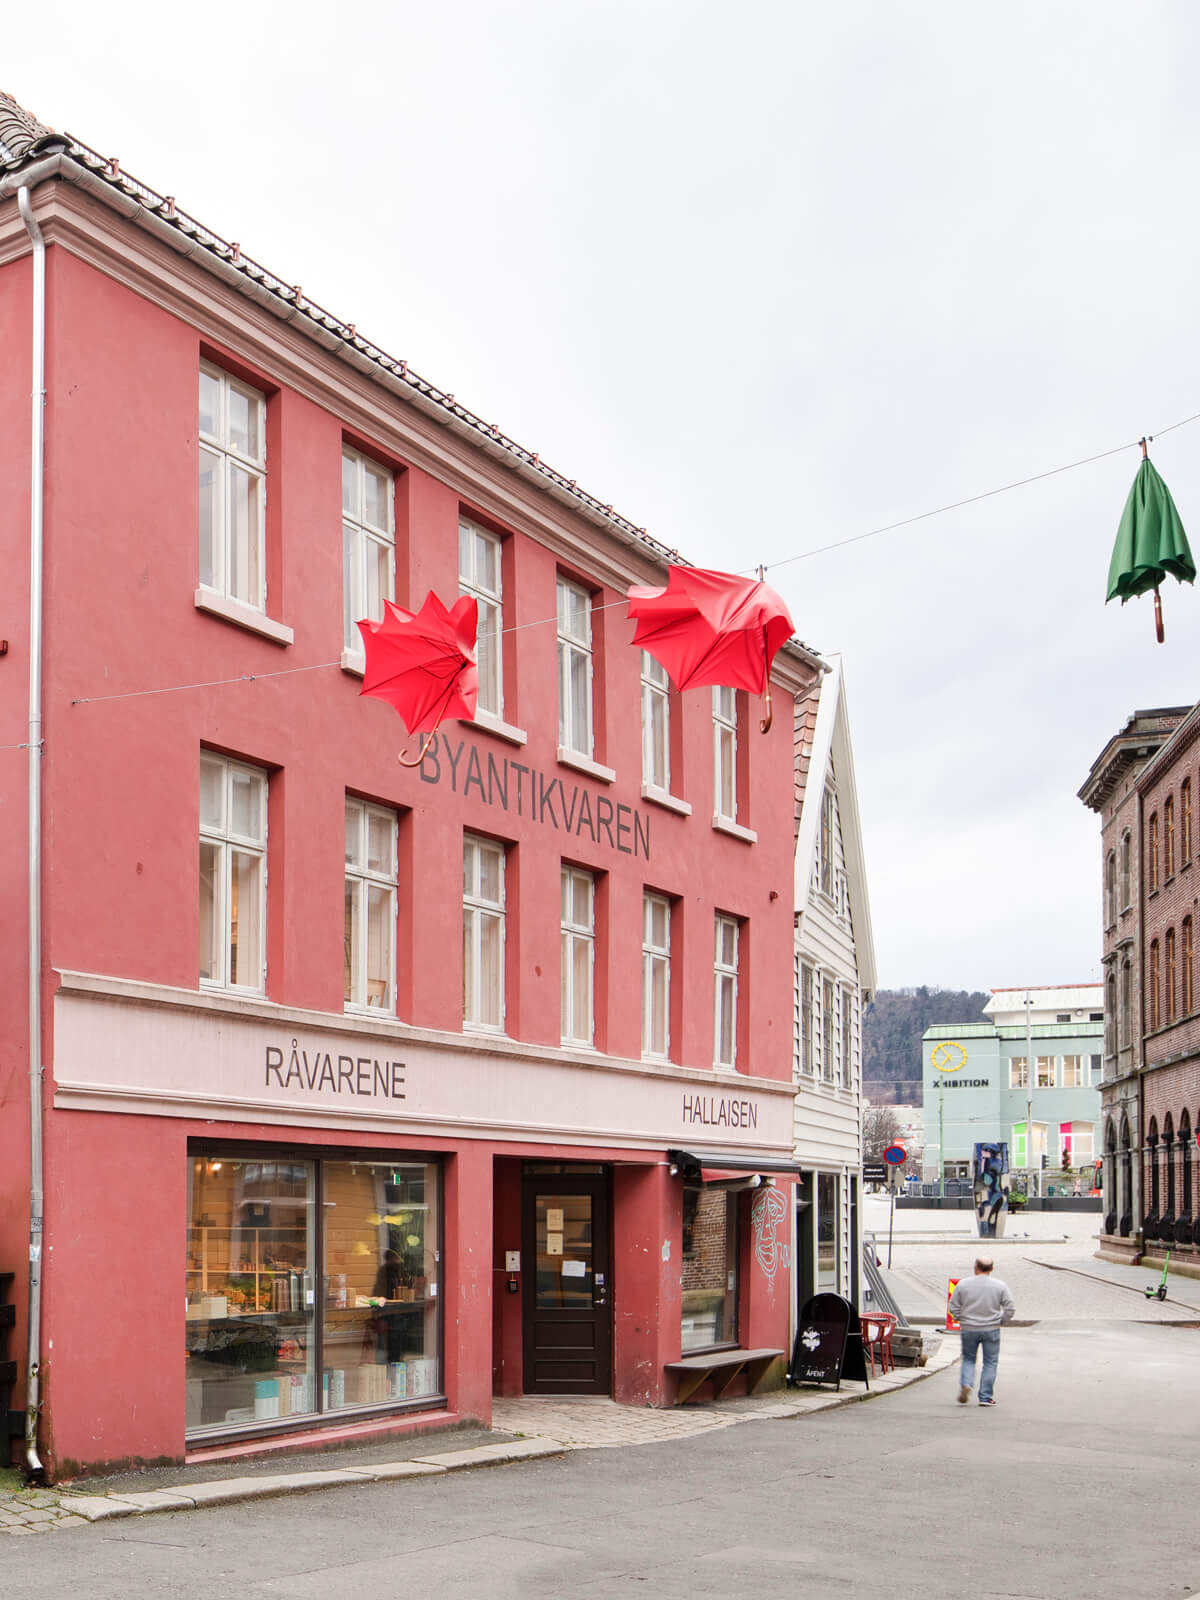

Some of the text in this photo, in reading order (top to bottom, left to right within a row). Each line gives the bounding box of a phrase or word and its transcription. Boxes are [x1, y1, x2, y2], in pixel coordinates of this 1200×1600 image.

[419, 732, 650, 861] BYANTIKVAREN
[265, 1038, 406, 1099] RÅVARENE
[682, 1094, 758, 1128] HALLAISEN
